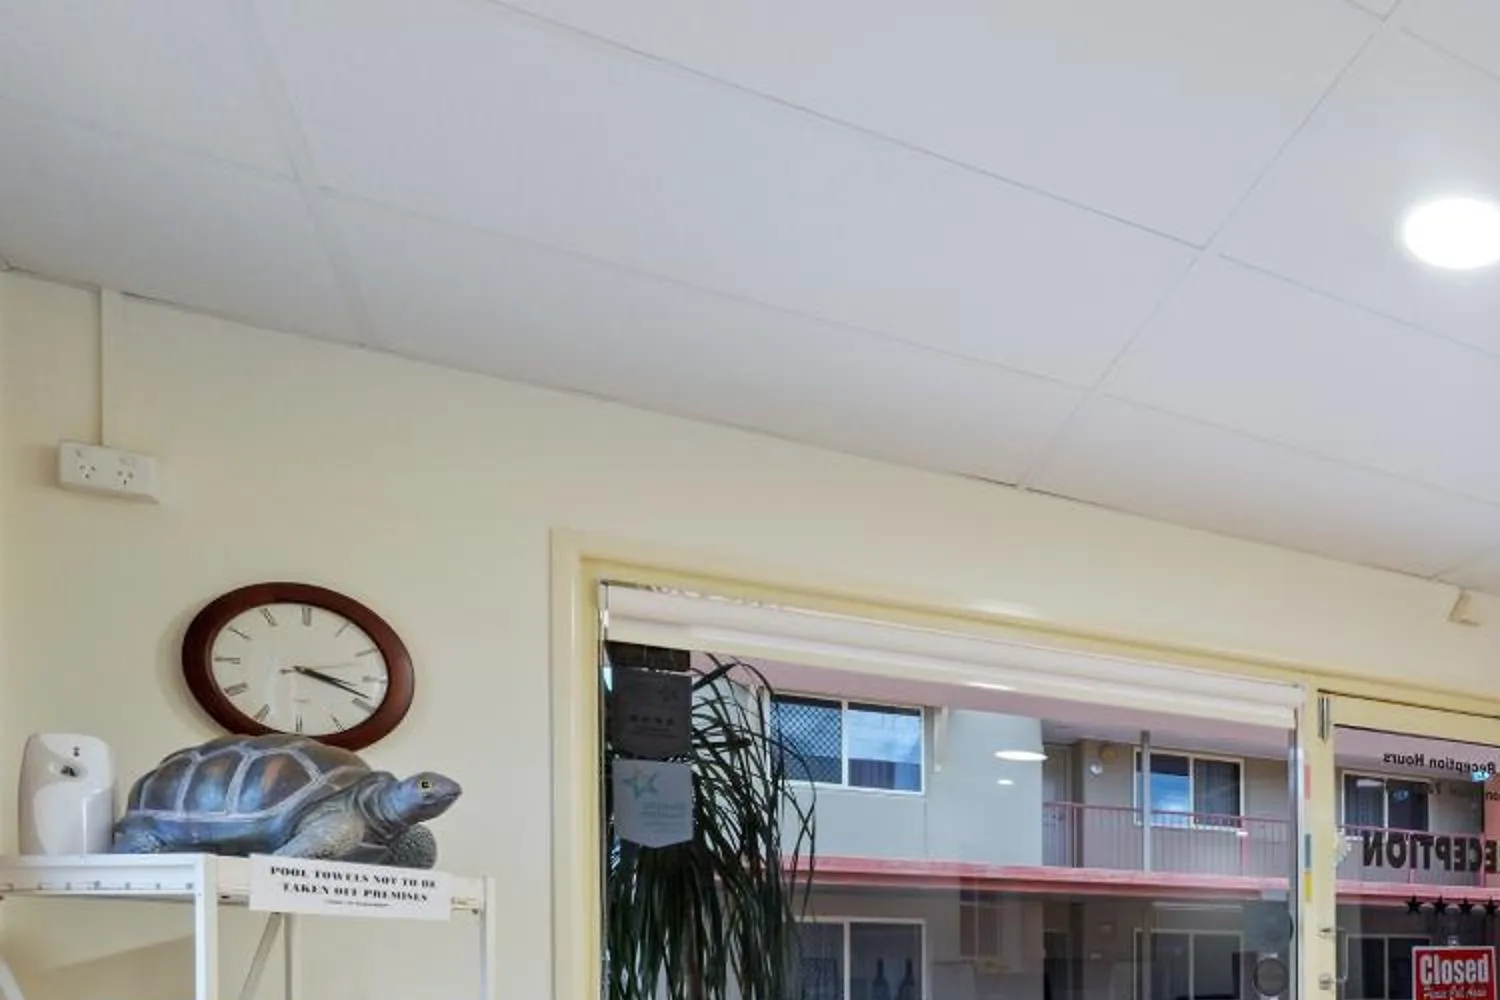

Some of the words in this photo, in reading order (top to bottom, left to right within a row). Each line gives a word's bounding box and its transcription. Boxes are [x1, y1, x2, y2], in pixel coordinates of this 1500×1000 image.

[270, 865, 308, 879] POOL
[314, 869, 370, 884] TOWELS
[373, 874, 399, 886] NOT
[402, 877, 419, 888] TO
[283, 883, 330, 895] TAKEN
[363, 889, 429, 901] PREMISES
[1420, 952, 1489, 985] Closed
